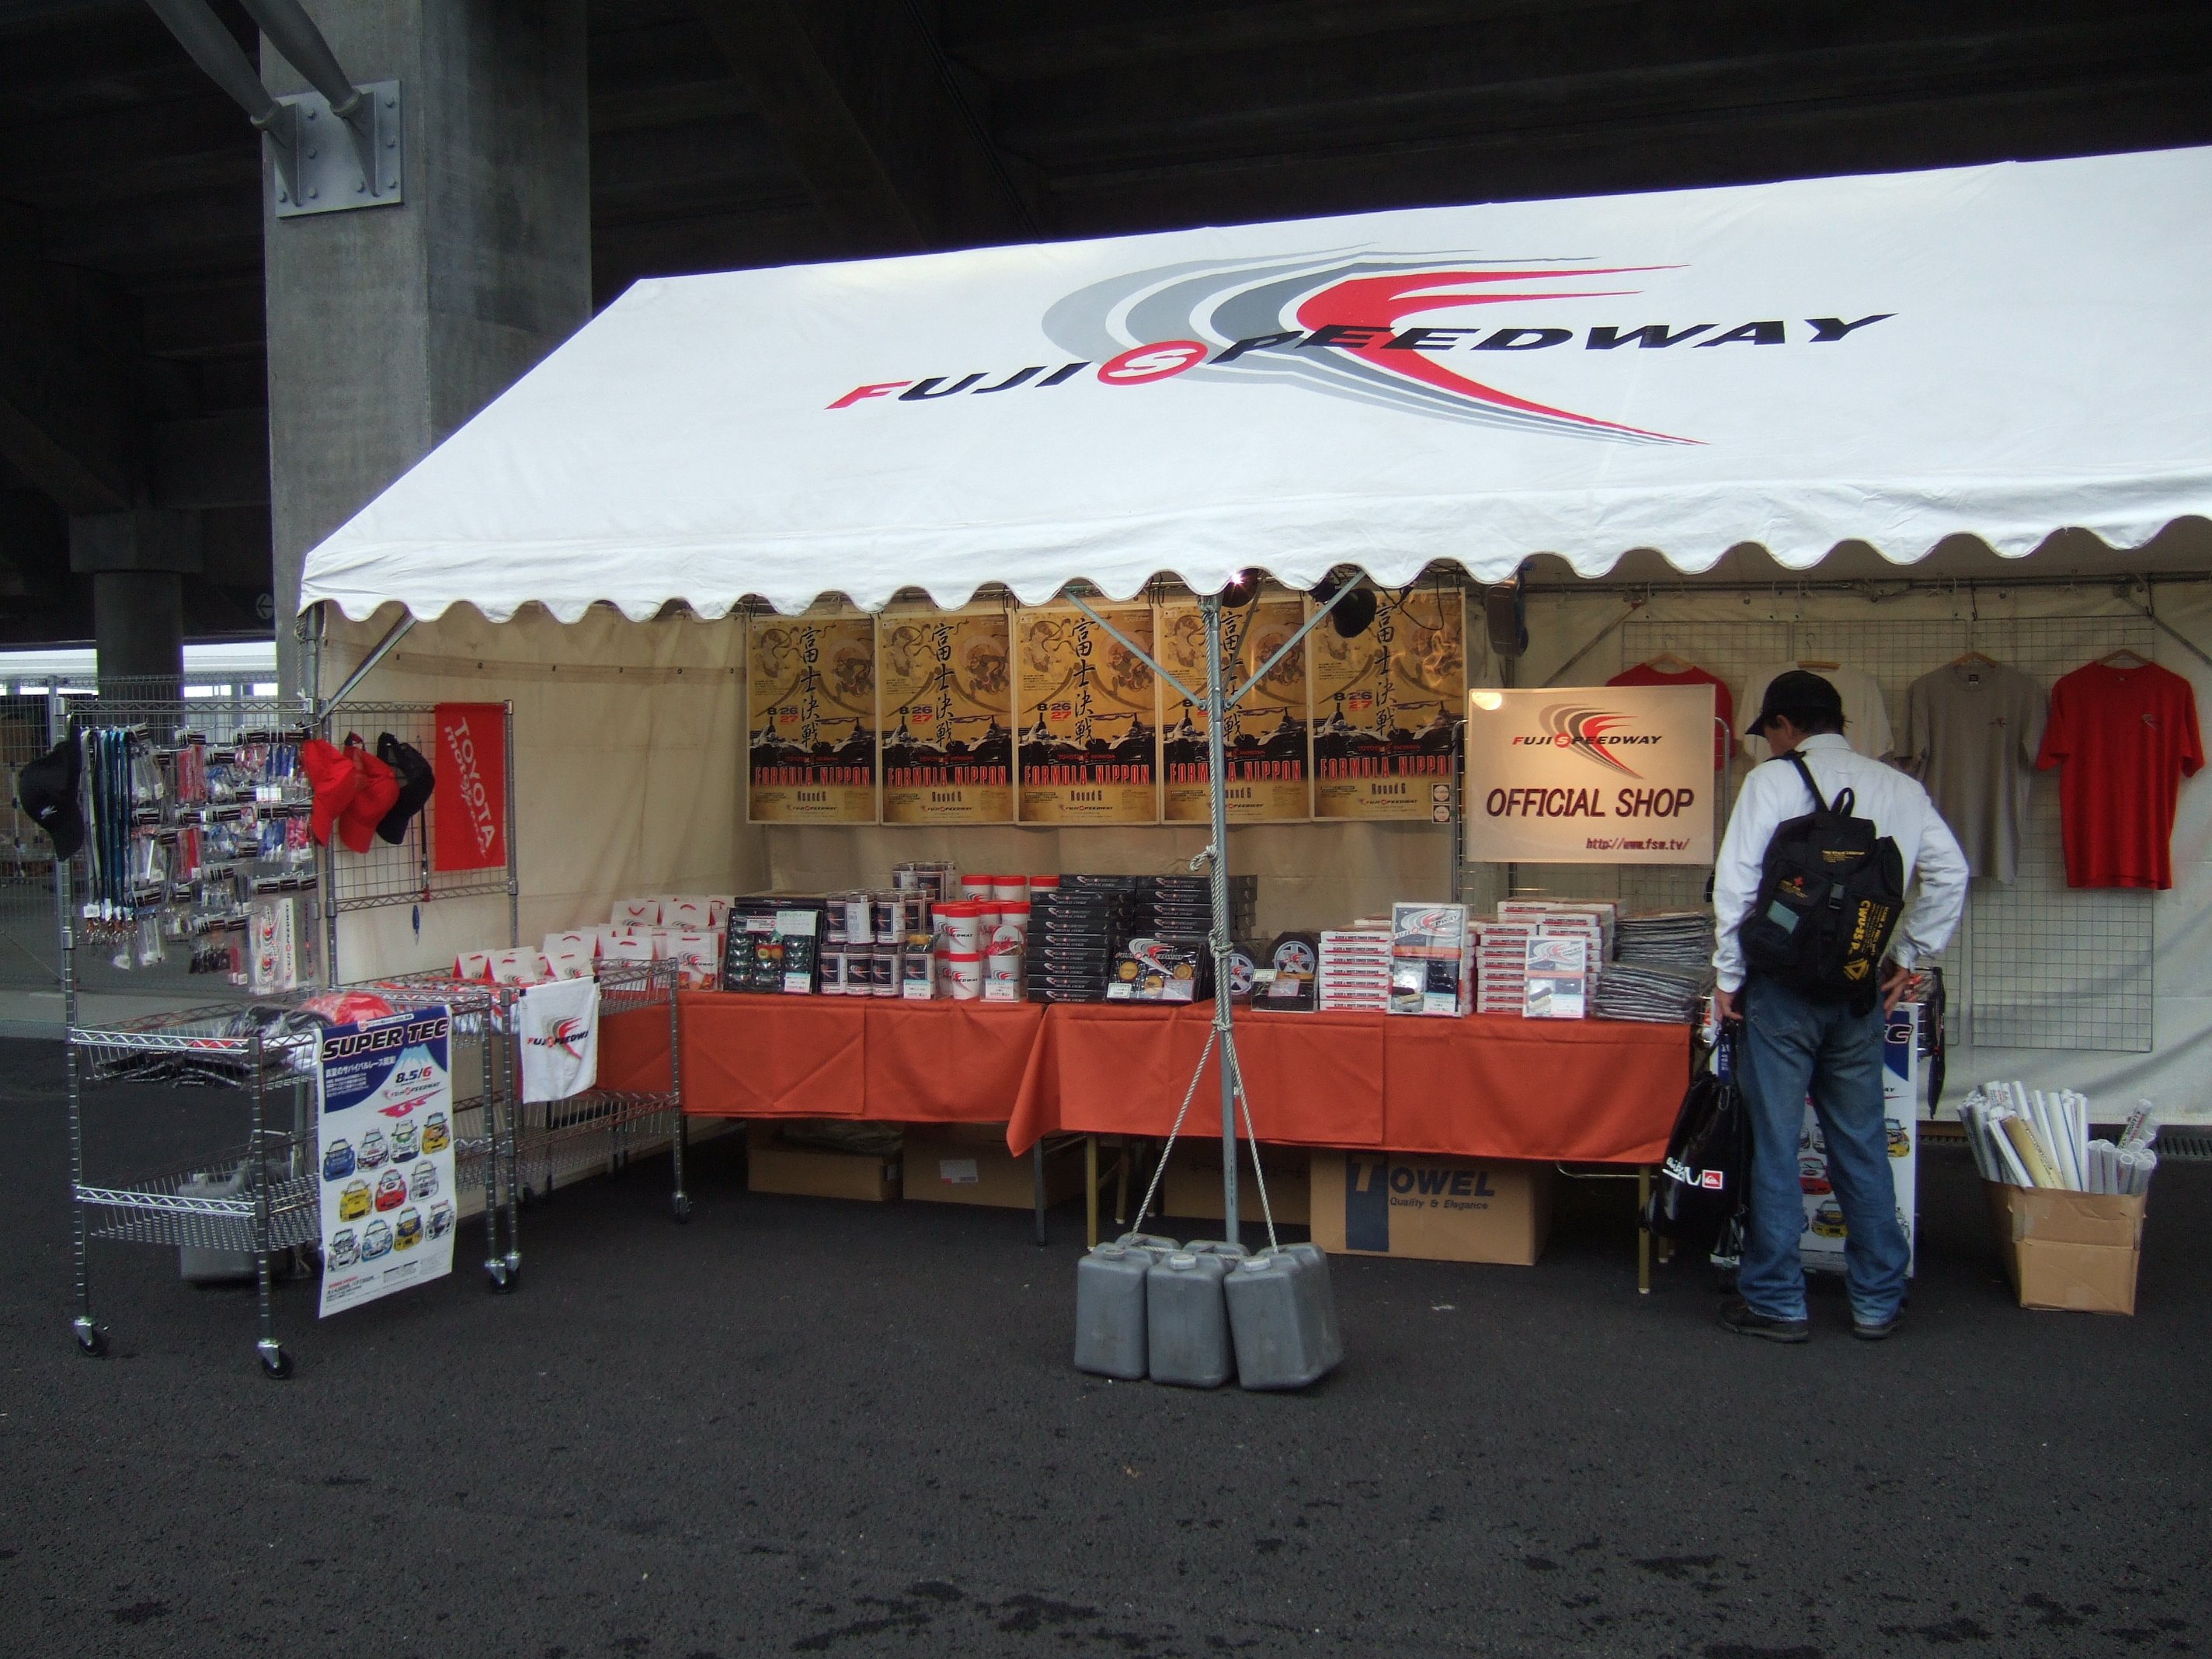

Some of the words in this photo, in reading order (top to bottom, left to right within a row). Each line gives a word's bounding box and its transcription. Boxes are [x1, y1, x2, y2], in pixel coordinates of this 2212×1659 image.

[1073, 617, 1096, 746] 富士決戦
[1221, 610, 1245, 742] 富士戦
[1375, 603, 1399, 737] 富士決戦
[800, 626, 822, 748] 富士決戦
[932, 622, 956, 747] 富士決戦
[912, 714, 933, 725] 27
[1051, 711, 1072, 721] 27
[1512, 736, 1553, 746] FUJI
[755, 767, 813, 788] FORMULA
[819, 767, 870, 788] NIPPON
[888, 766, 948, 788] FORMULA
[955, 765, 1007, 788] NIPPON
[1024, 765, 1087, 788] FORMULA
[1095, 763, 1149, 787] NIPPON
[1170, 761, 1236, 785] FORMA
[1244, 760, 1301, 783] NIPPON
[1320, 756, 1390, 781] FORMULA
[454, 716, 496, 849] TOYOTA
[1225, 788, 1244, 799] ound
[1372, 783, 1398, 795] Round
[797, 791, 820, 802] Round
[932, 791, 955, 802] Round
[1070, 790, 1095, 802] Round
[1486, 788, 1605, 817] OFFICIAL
[1616, 788, 1695, 817] SHOP
[320, 1026, 405, 1062] SUPER
[408, 1017, 450, 1044] TEC
[395, 1066, 433, 1084] 8.5/6
[1351, 1154, 1496, 1197] TOWEL
[1390, 1196, 1424, 1209] Quality
[1430, 1198, 1438, 1208] &
[1444, 1198, 1488, 1211] Elegance
